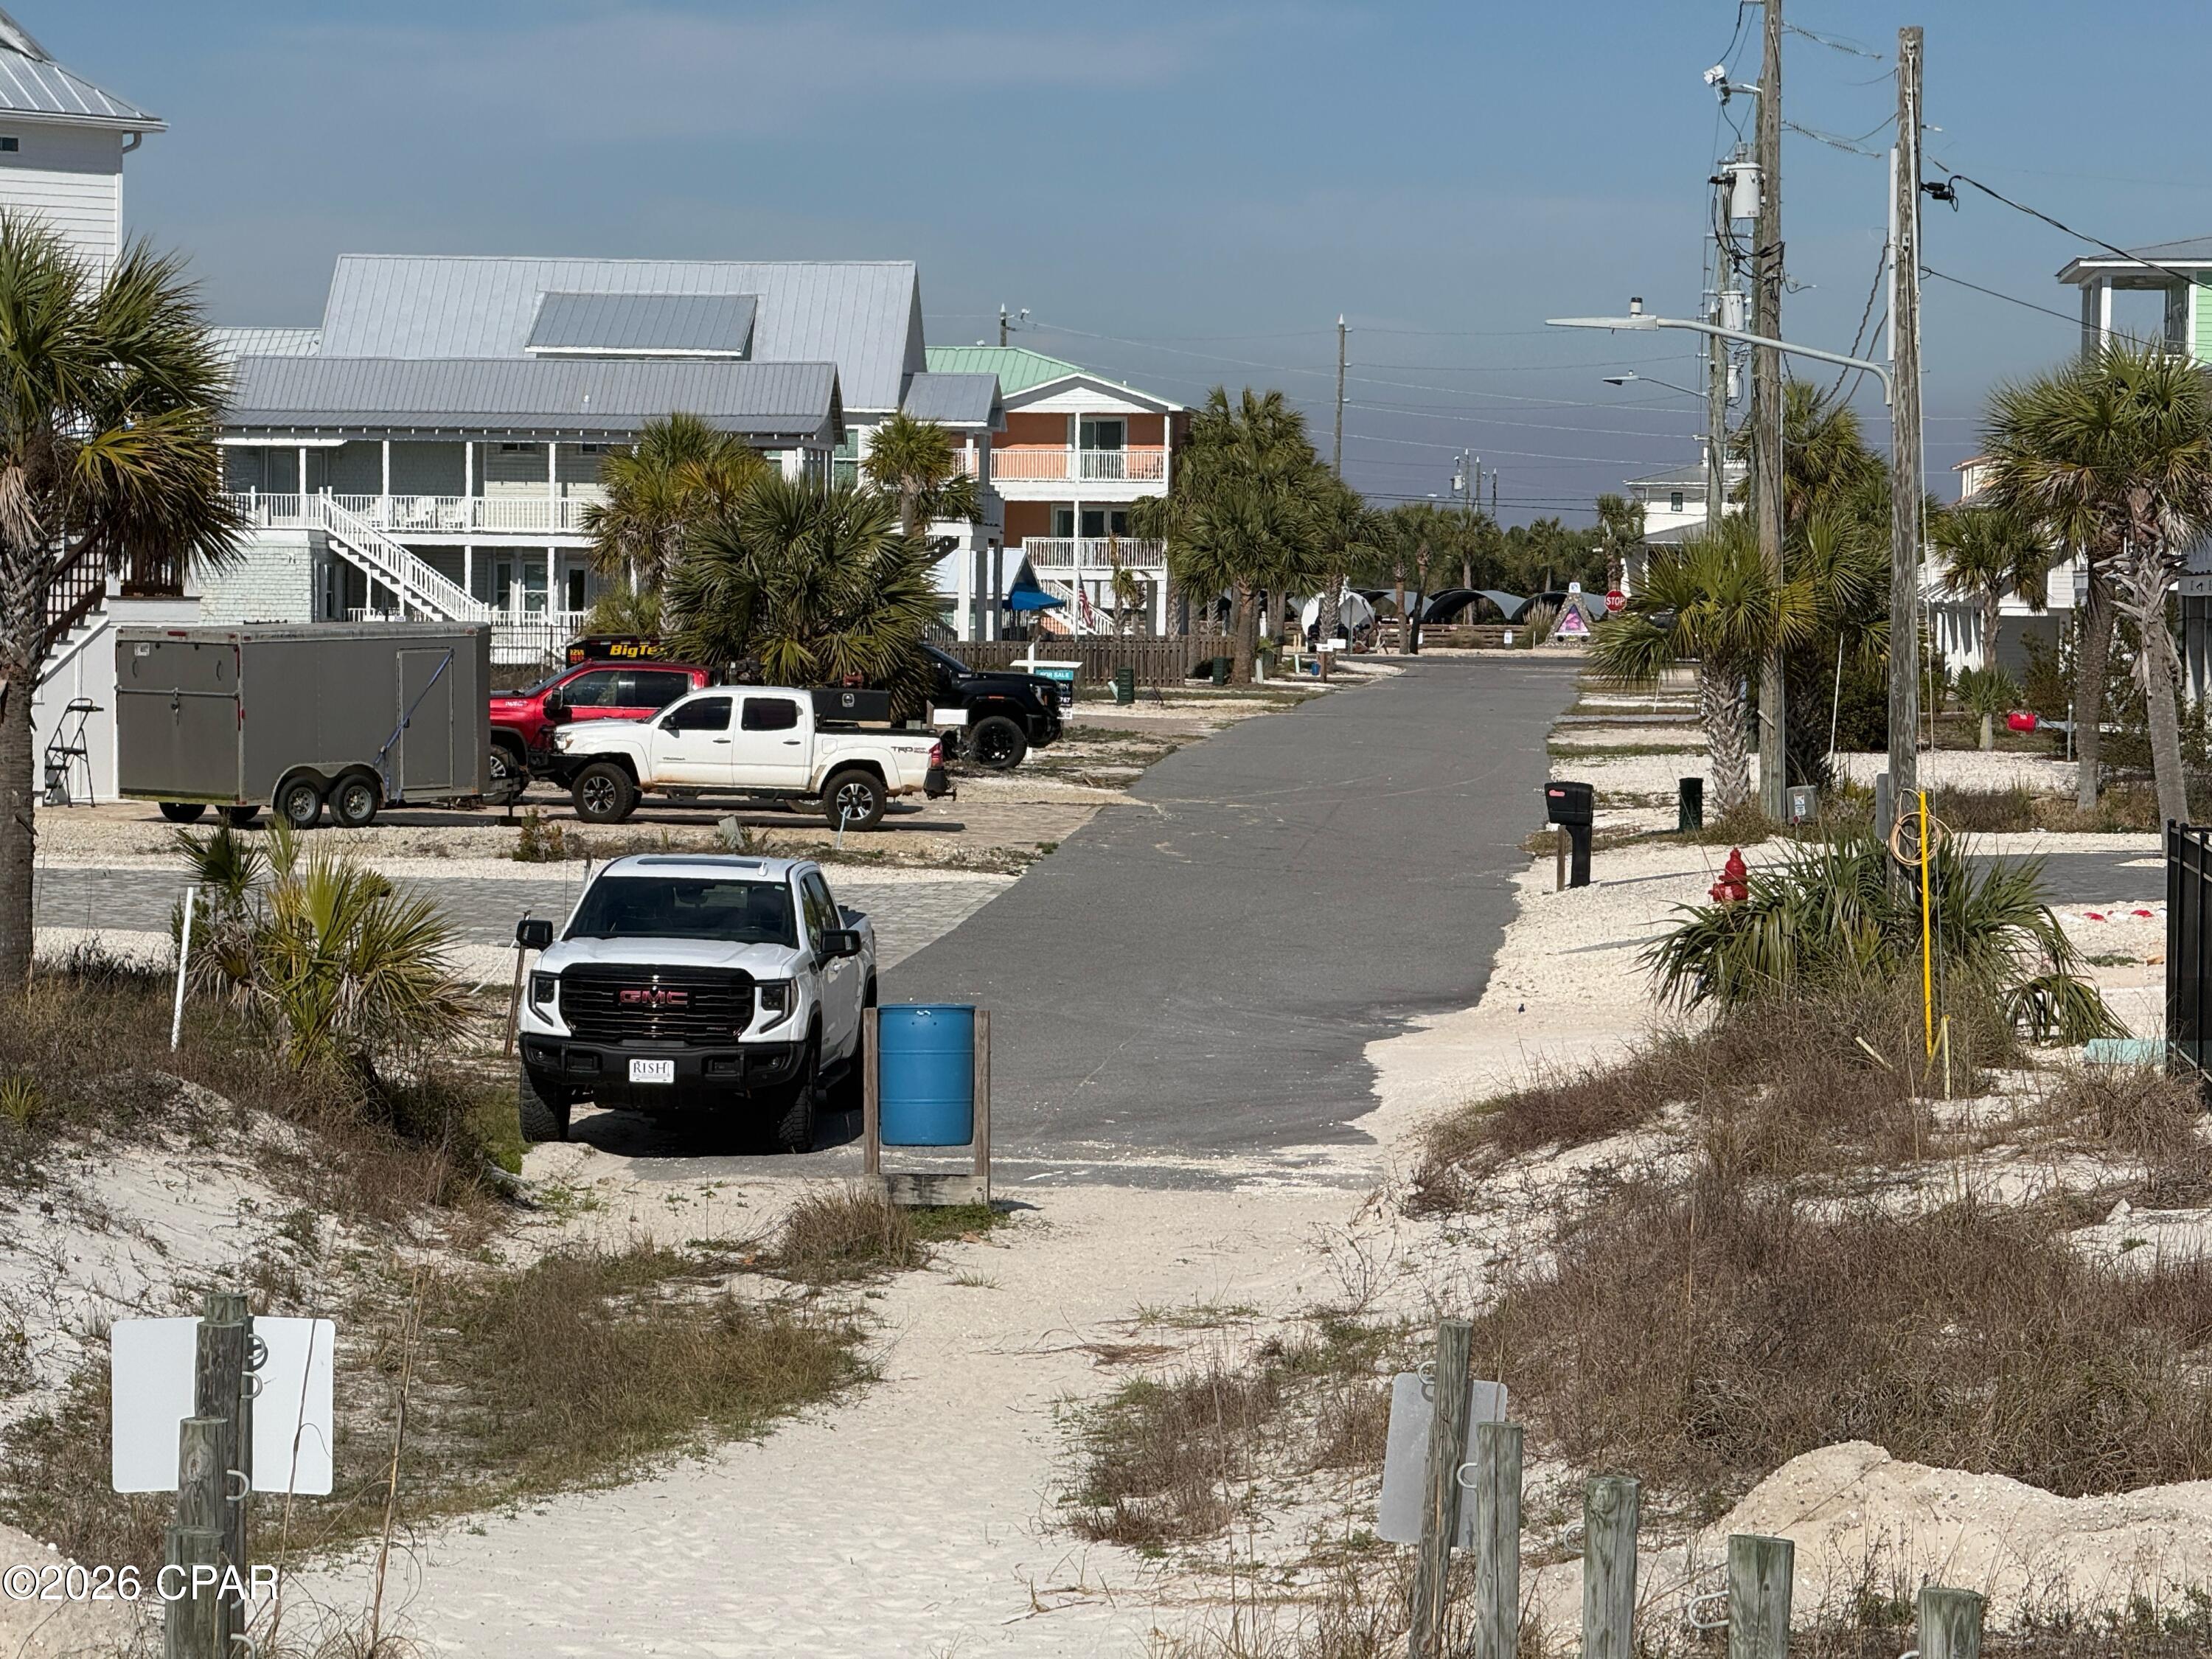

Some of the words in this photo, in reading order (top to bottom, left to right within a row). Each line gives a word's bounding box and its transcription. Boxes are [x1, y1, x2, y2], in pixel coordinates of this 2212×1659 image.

[1606, 597, 1625, 606] STOP
[610, 644, 665, 657] BigTe
[620, 990, 688, 1005] GMC
[633, 1061, 667, 1074] RISH
